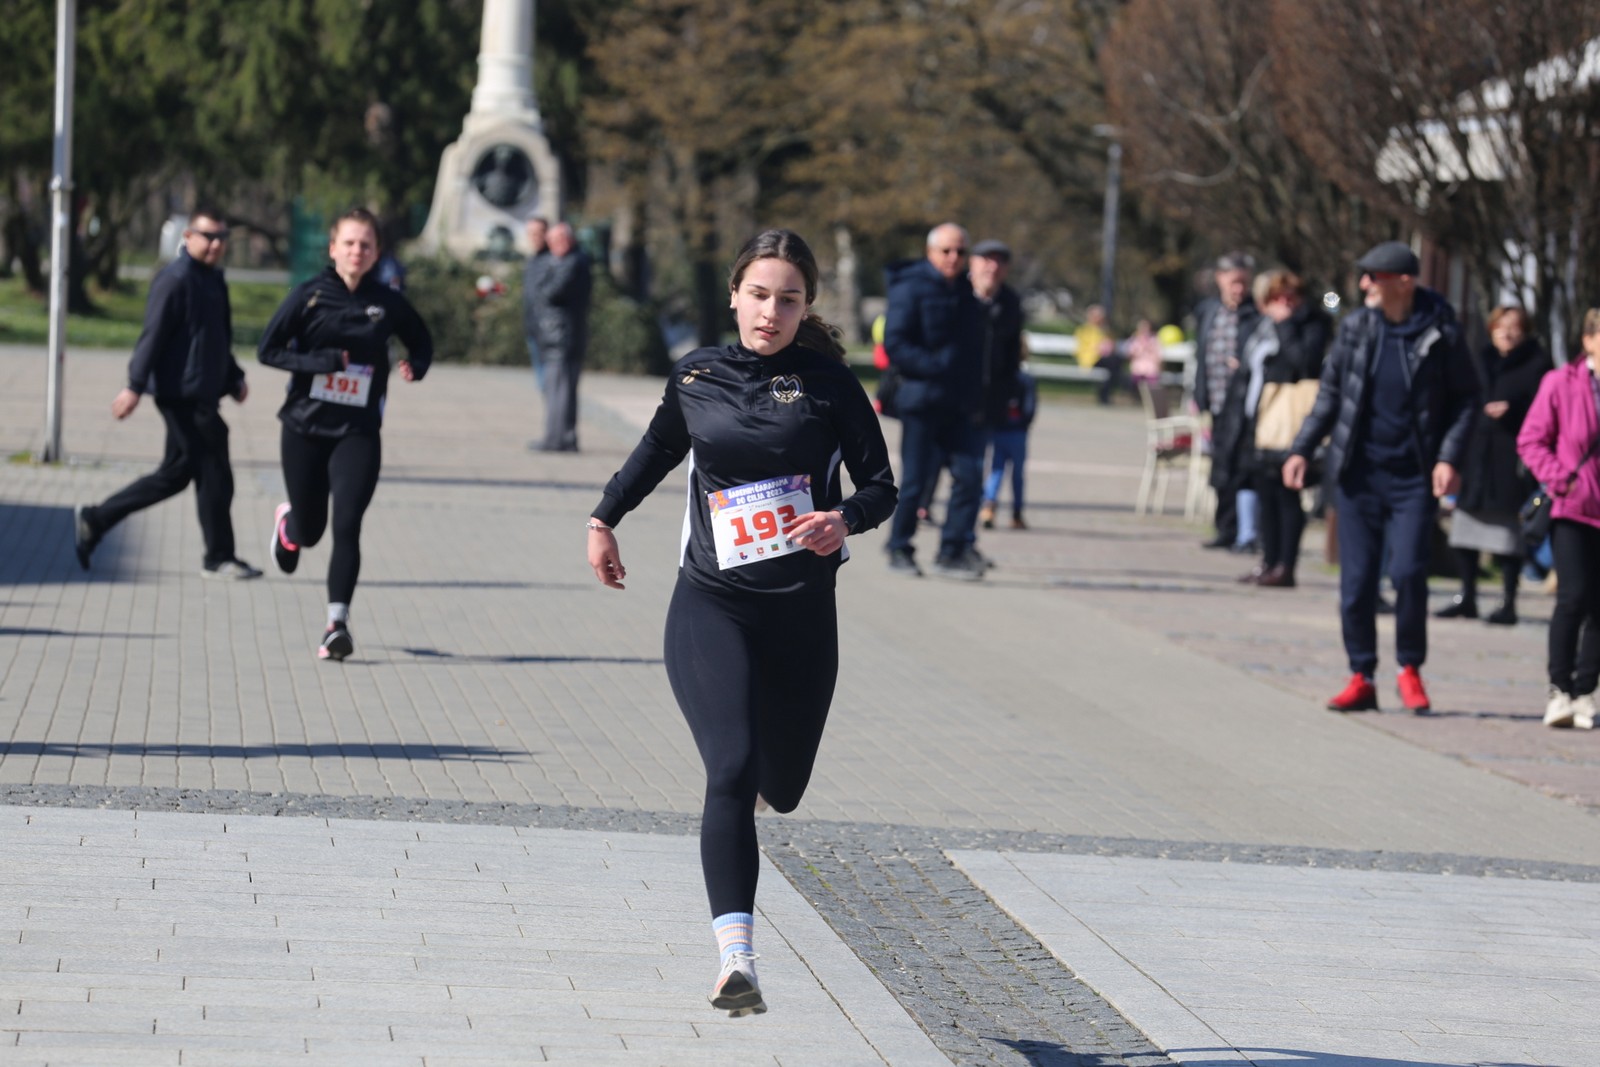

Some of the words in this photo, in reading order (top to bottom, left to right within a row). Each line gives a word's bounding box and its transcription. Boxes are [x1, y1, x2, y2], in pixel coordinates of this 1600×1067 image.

[323, 374, 359, 394] 191
[736, 496, 746, 505] DO
[747, 493, 765, 502] CILJA
[730, 504, 797, 546] 193
